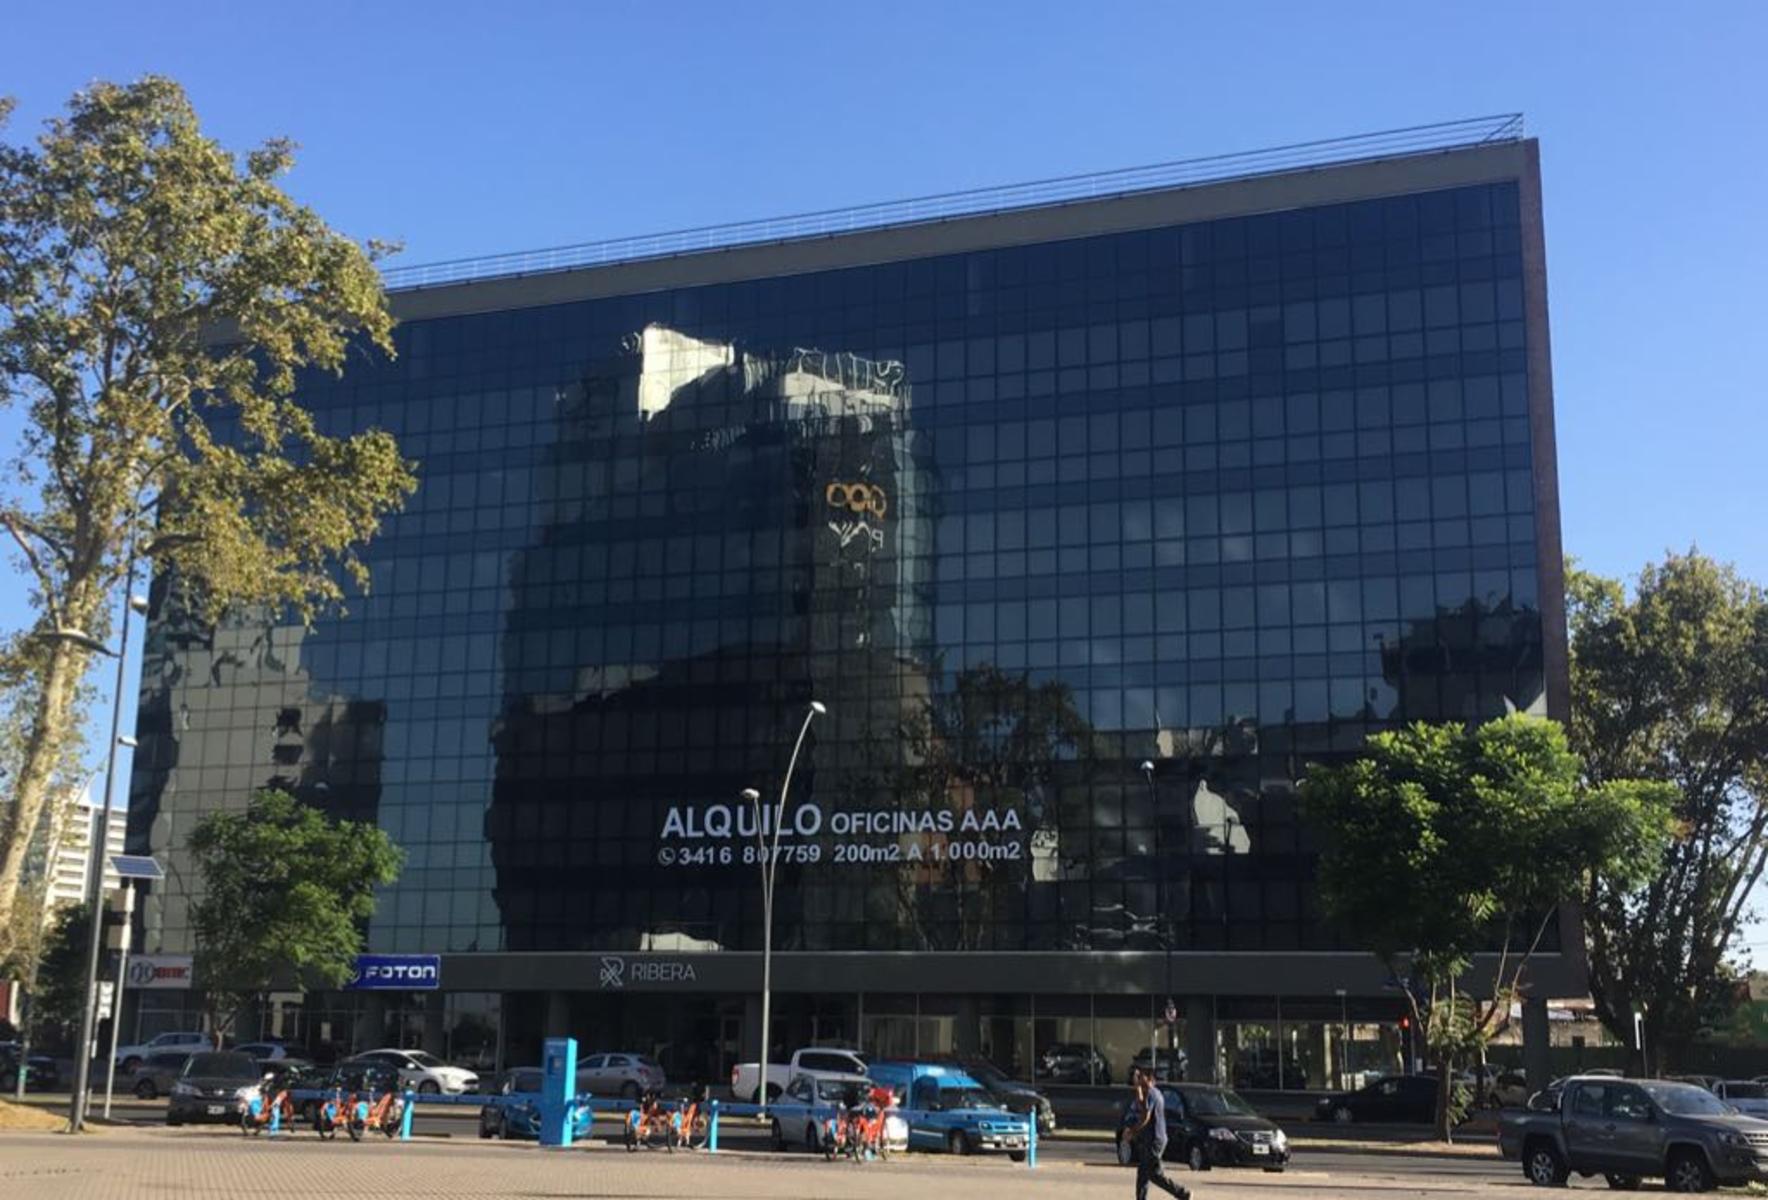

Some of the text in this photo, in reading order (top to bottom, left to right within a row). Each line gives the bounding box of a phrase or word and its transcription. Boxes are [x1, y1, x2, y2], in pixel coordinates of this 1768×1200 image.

[660, 804, 1022, 838] ALQUILO OFICINAS AAA
[678, 841, 1020, 865] 3416 807759 200m2 A 1.000m2
[365, 965, 436, 979] FOTON
[631, 963, 696, 981] RIBERA
